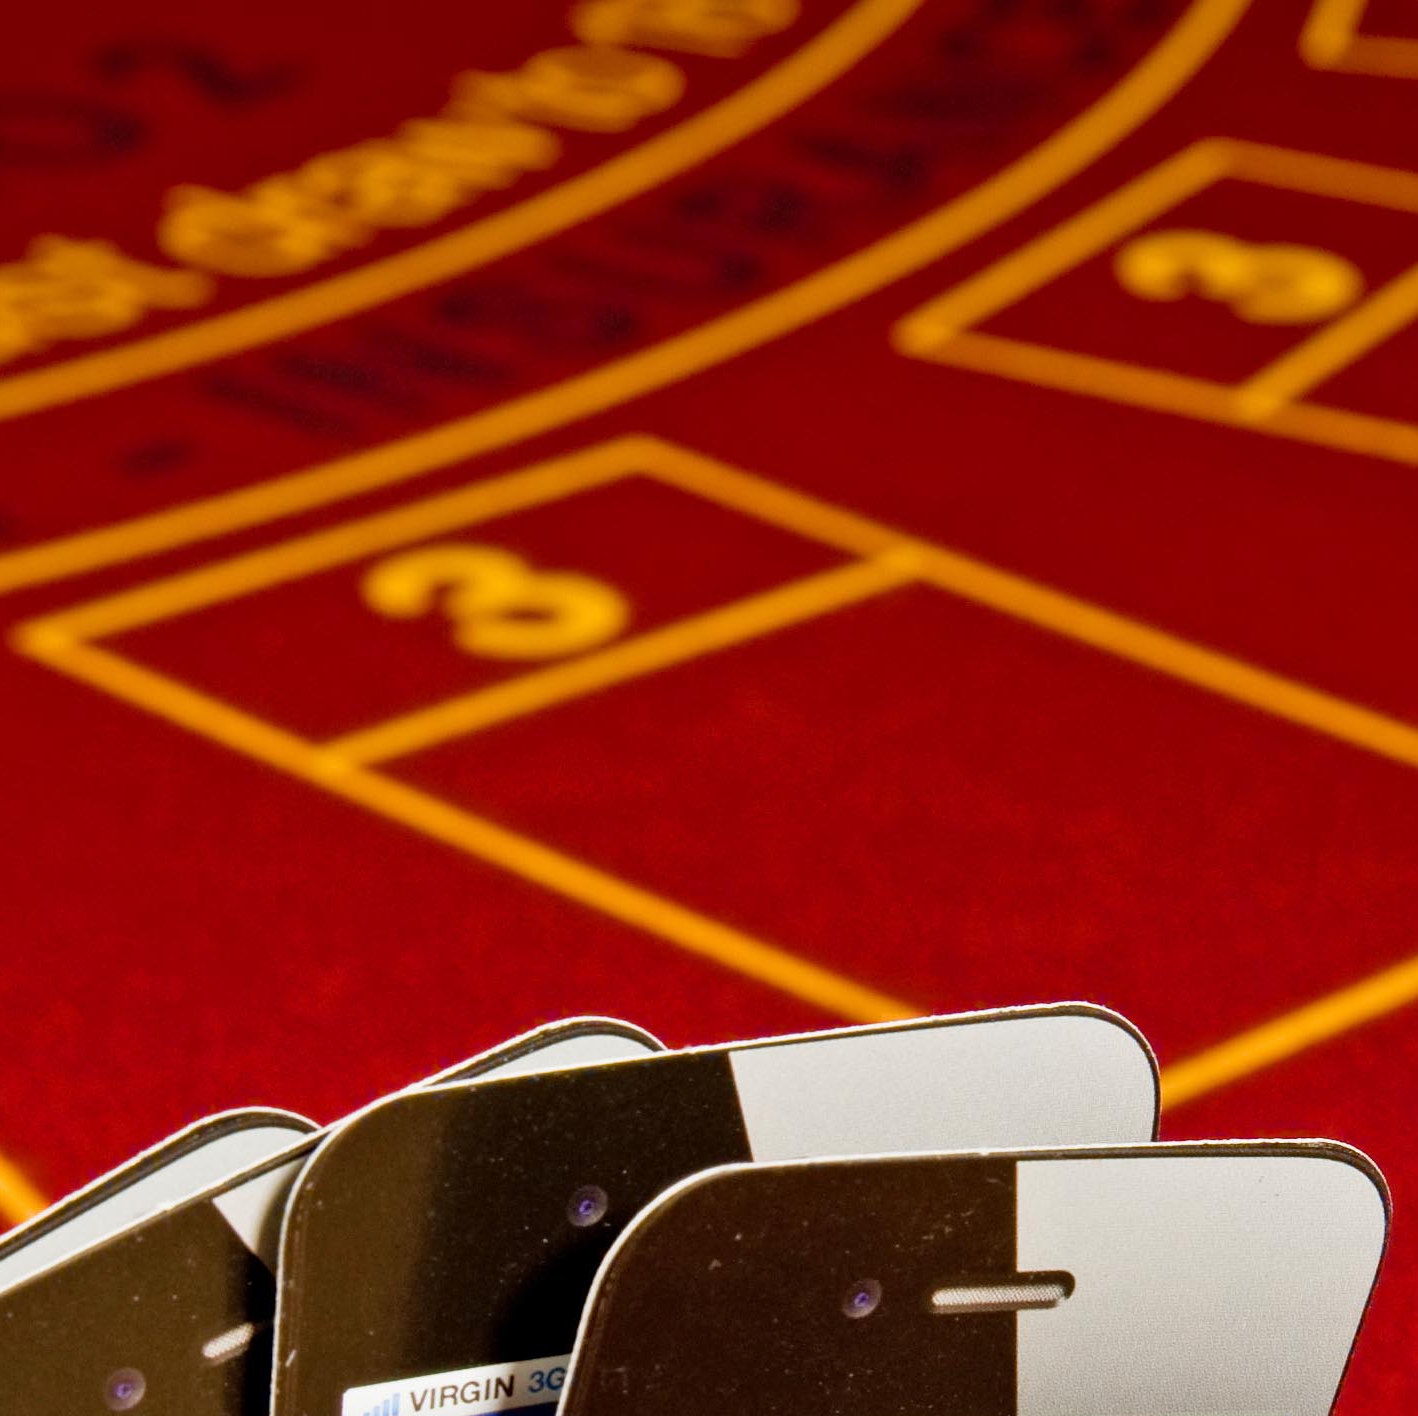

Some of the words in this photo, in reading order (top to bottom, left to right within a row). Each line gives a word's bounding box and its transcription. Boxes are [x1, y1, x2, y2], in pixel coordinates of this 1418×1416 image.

[363, 541, 631, 663] 3
[410, 1375, 515, 1413] VIRGIN
[527, 1367, 567, 1393] 3G
